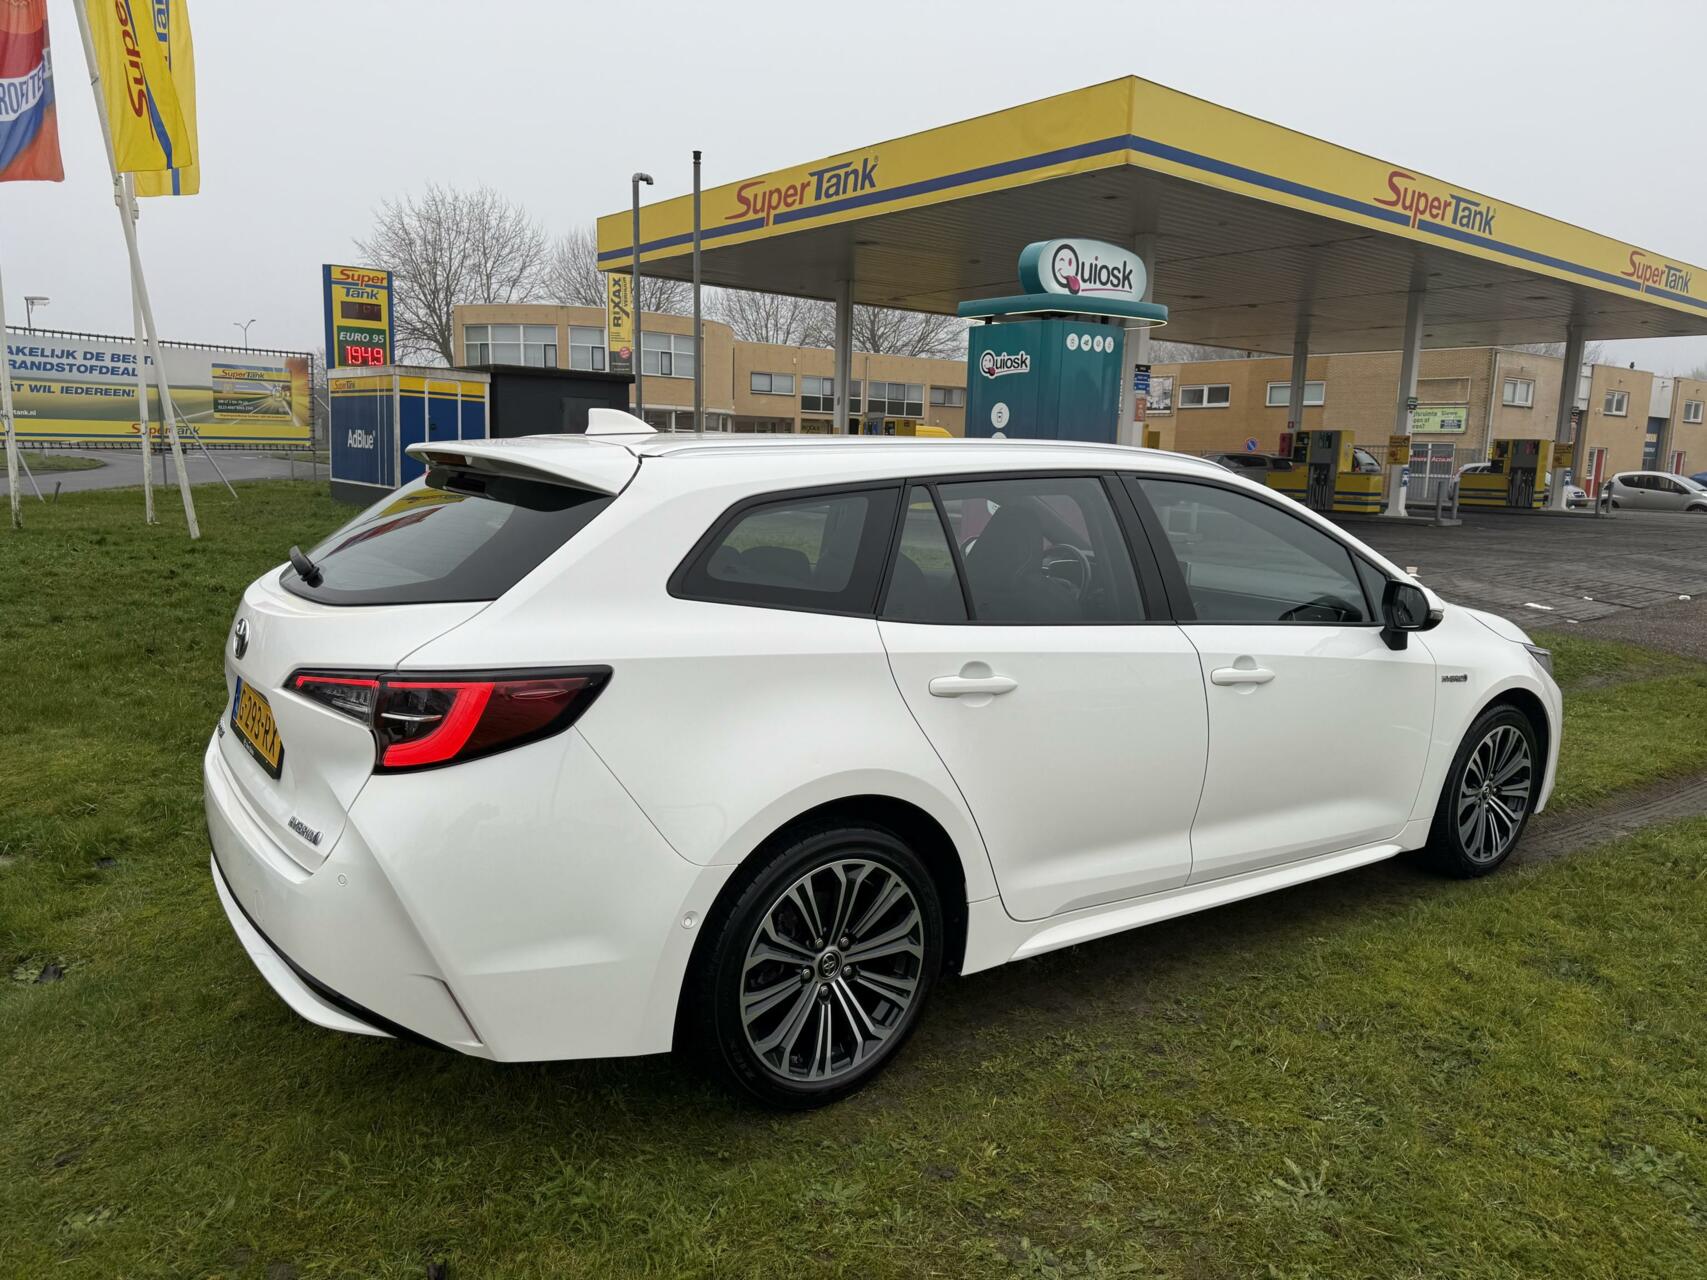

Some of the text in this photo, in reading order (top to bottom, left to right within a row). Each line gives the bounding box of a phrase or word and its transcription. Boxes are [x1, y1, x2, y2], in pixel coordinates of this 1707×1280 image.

[725, 156, 878, 227] SuperTank
[1373, 170, 1495, 236] SuperTank
[337, 268, 387, 288] Super
[1051, 243, 1133, 294] Quiosk
[1621, 250, 1691, 294] SuperTank
[342, 286, 380, 300] Tank
[611, 276, 629, 328] RIXAX
[340, 331, 385, 343] EURO 95
[83, 351, 105, 362] DE
[345, 344, 384, 366] 194.9
[980, 351, 1029, 375] Quiosk
[28, 384, 56, 394] WIL
[60, 386, 135, 398] IEDEREEN!
[347, 429, 375, 449] AdBlue
